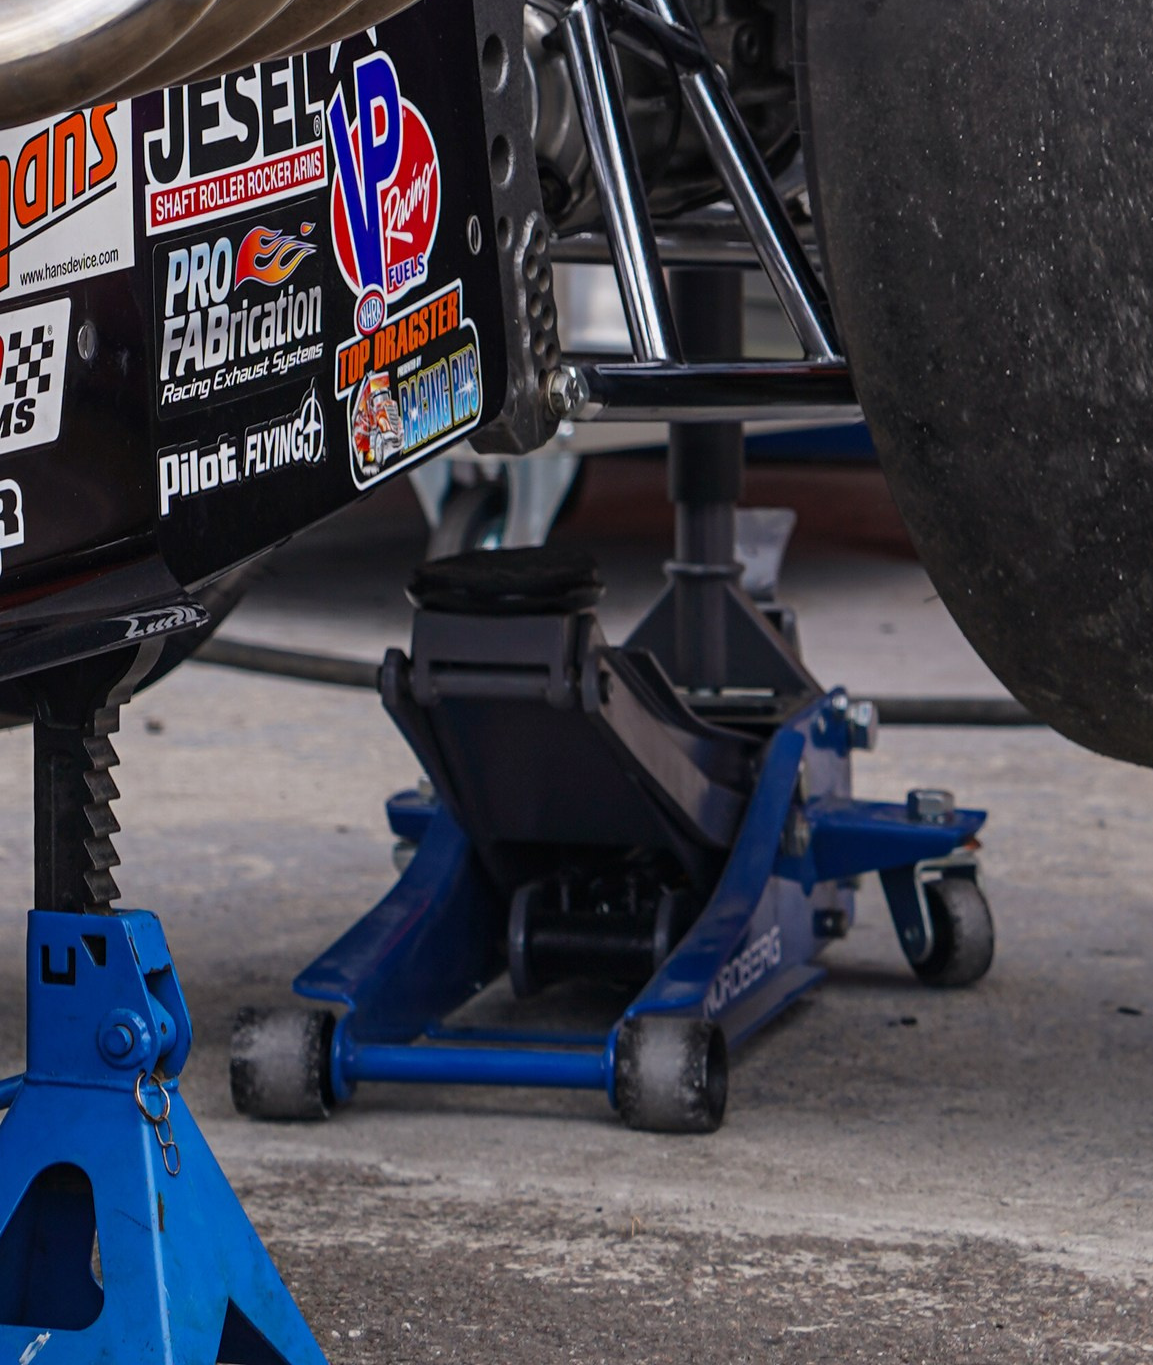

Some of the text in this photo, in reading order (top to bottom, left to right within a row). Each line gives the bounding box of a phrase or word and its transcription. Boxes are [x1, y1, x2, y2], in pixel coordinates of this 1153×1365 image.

[147, 53, 325, 184] JESEL
[155, 151, 322, 221] SHAFT ROLLER ROCKER ARMS
[329, 57, 401, 290] VP
[384, 161, 437, 264] Racing
[19, 246, 119, 287] www.hansdevice.com
[164, 236, 233, 317] PRO
[359, 298, 384, 329] NHRA
[388, 254, 426, 288] FUELS
[160, 284, 323, 381] FABrication
[161, 342, 324, 406] Racing Exhaust Systems
[339, 290, 458, 390] TOP DRAGSTER
[398, 358, 452, 455] RACING
[159, 442, 238, 517] Pilot
[244, 417, 304, 477] FLYING
